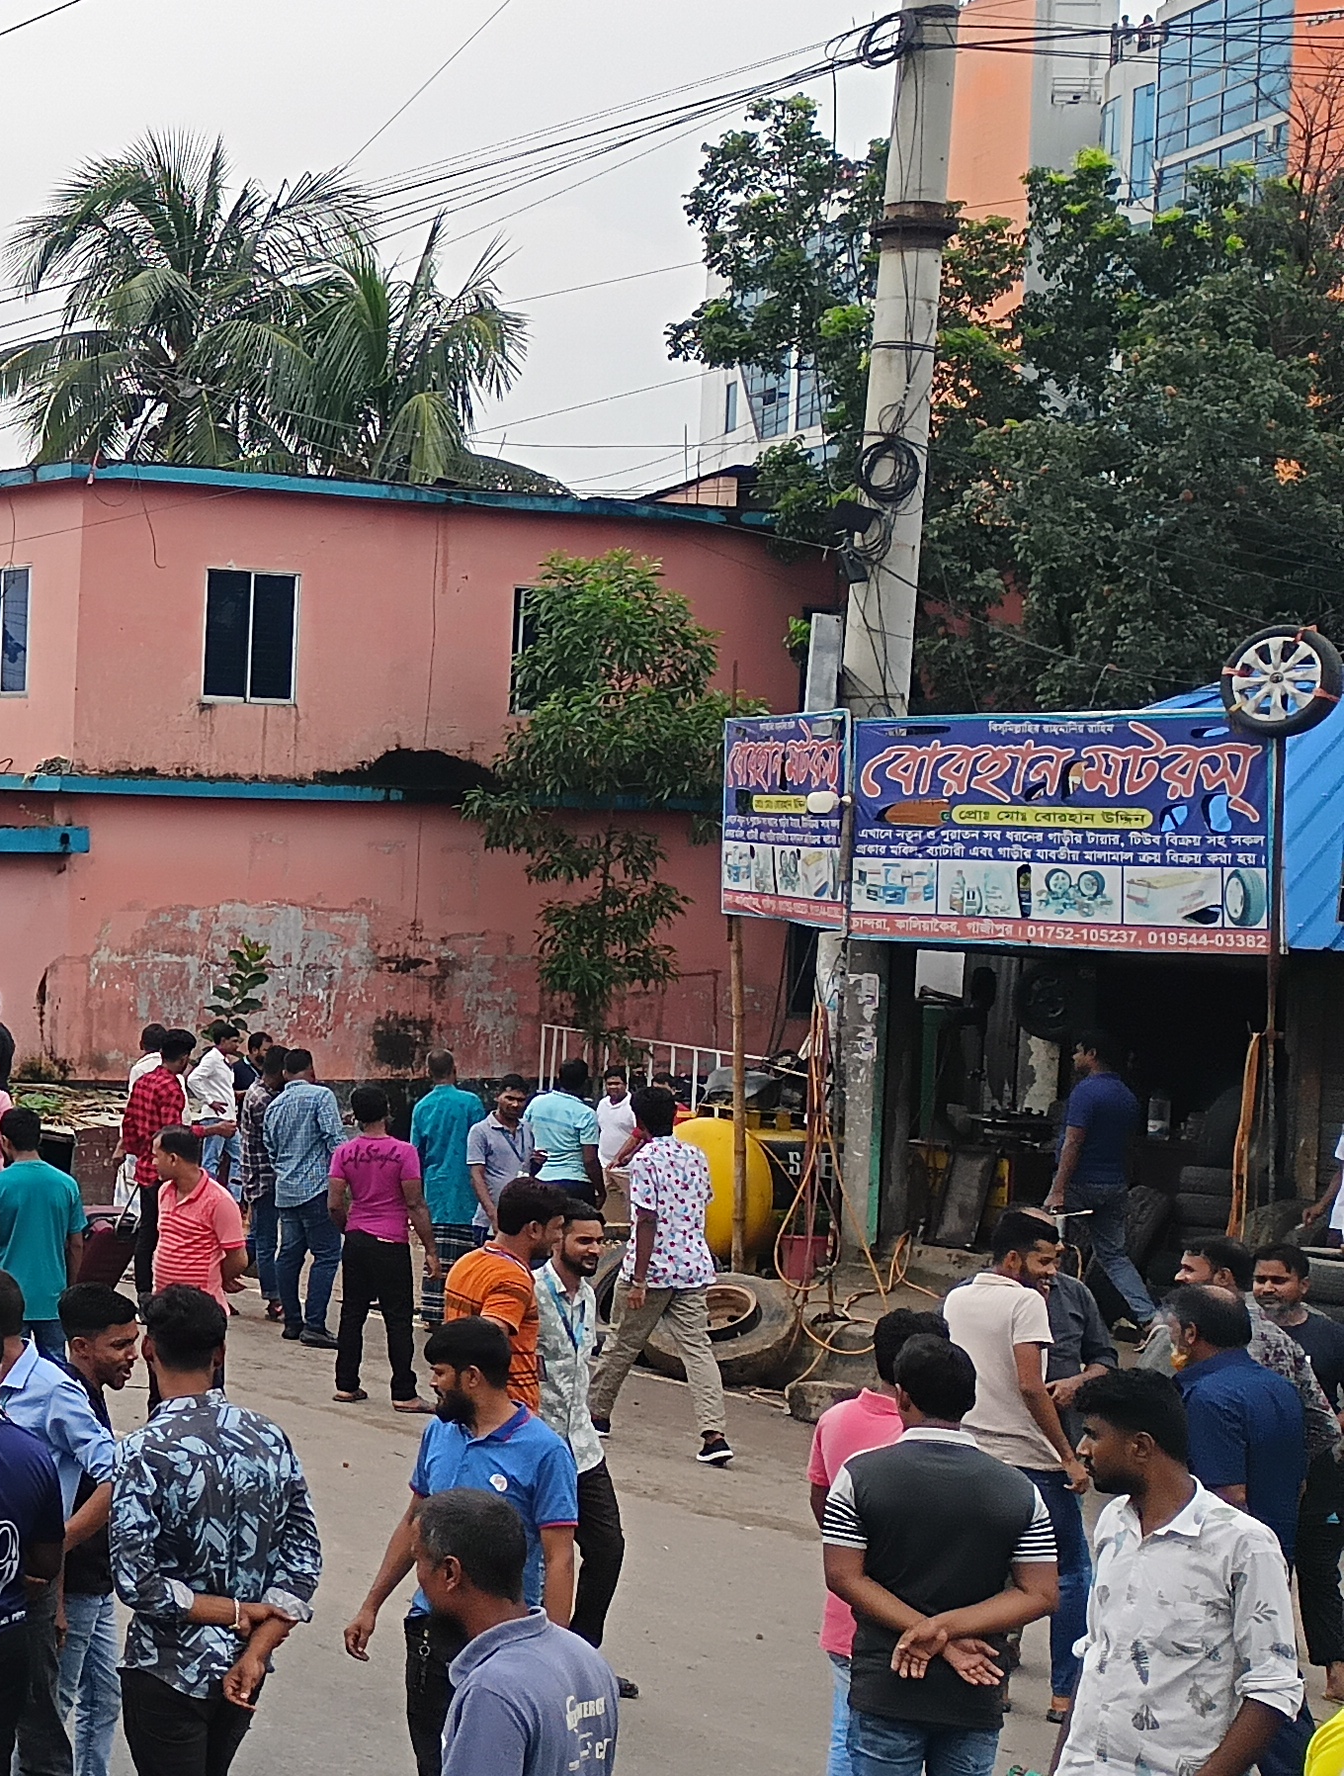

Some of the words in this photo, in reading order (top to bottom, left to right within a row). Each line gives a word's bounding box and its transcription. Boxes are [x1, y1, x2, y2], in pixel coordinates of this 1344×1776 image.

[861, 740, 1075, 803] বোরহান
[1034, 811, 1095, 824] বোরহান
[1101, 811, 1147, 825] উদ্দিন
[896, 830, 923, 843] নতুন
[1206, 834, 1227, 848] সহ
[1147, 934, 1267, 949] 019544-03382
